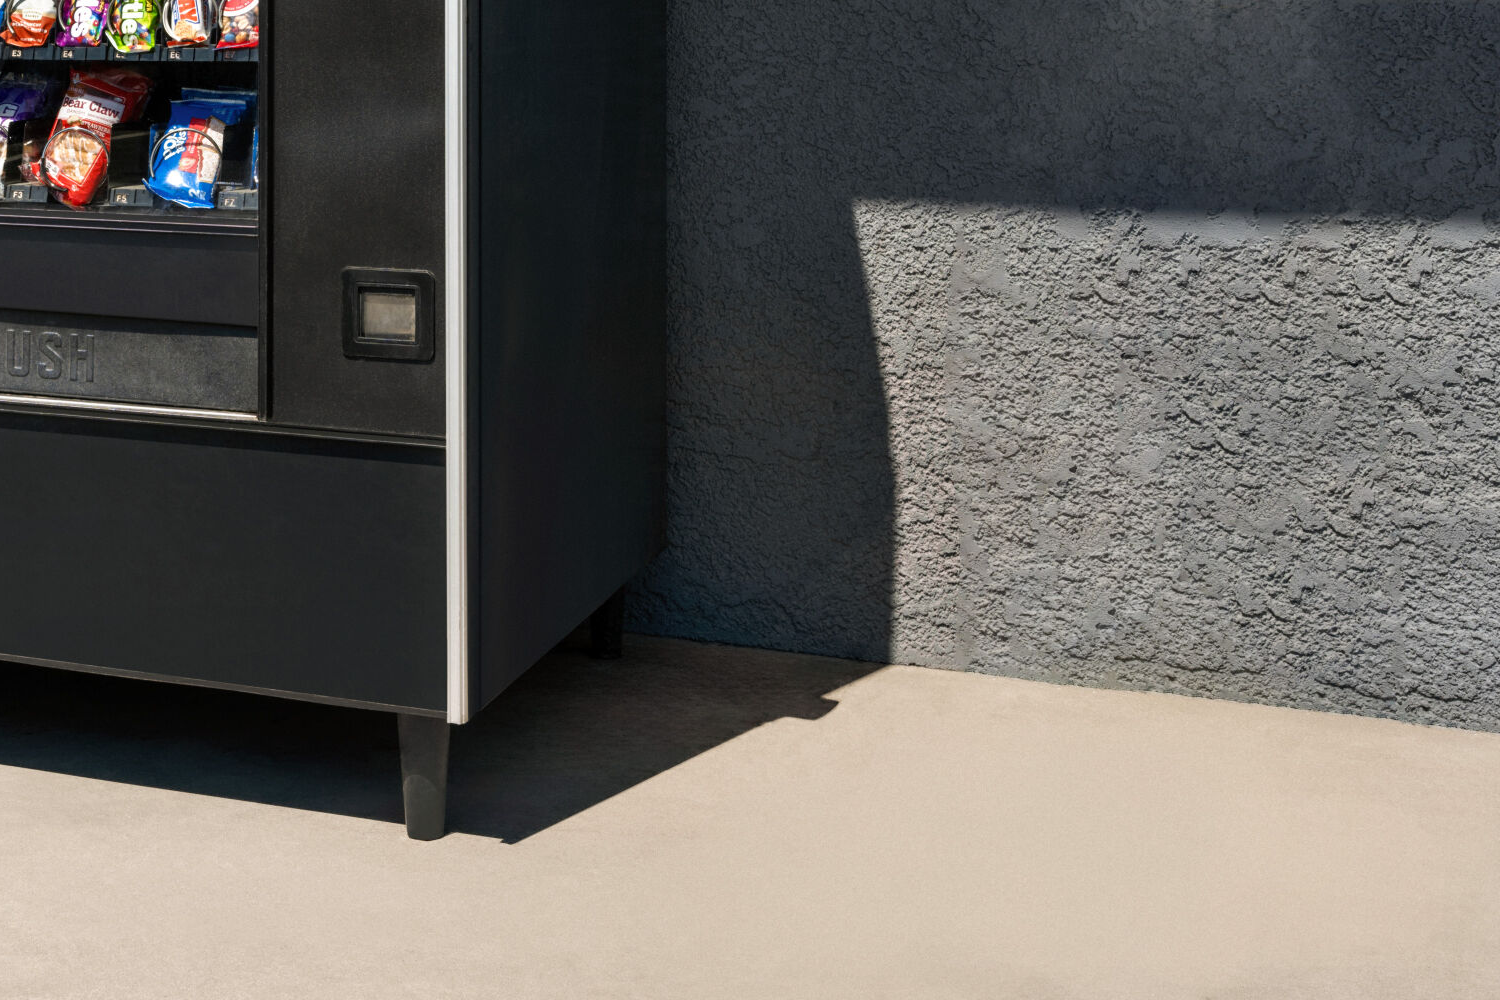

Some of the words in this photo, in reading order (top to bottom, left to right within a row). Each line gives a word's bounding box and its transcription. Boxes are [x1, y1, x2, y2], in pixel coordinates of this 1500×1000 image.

[63, 50, 73, 58] E4
[63, 96, 87, 109] Bear
[89, 100, 120, 119] Claw
[13, 191, 24, 199] F3
[224, 199, 236, 207] F7
